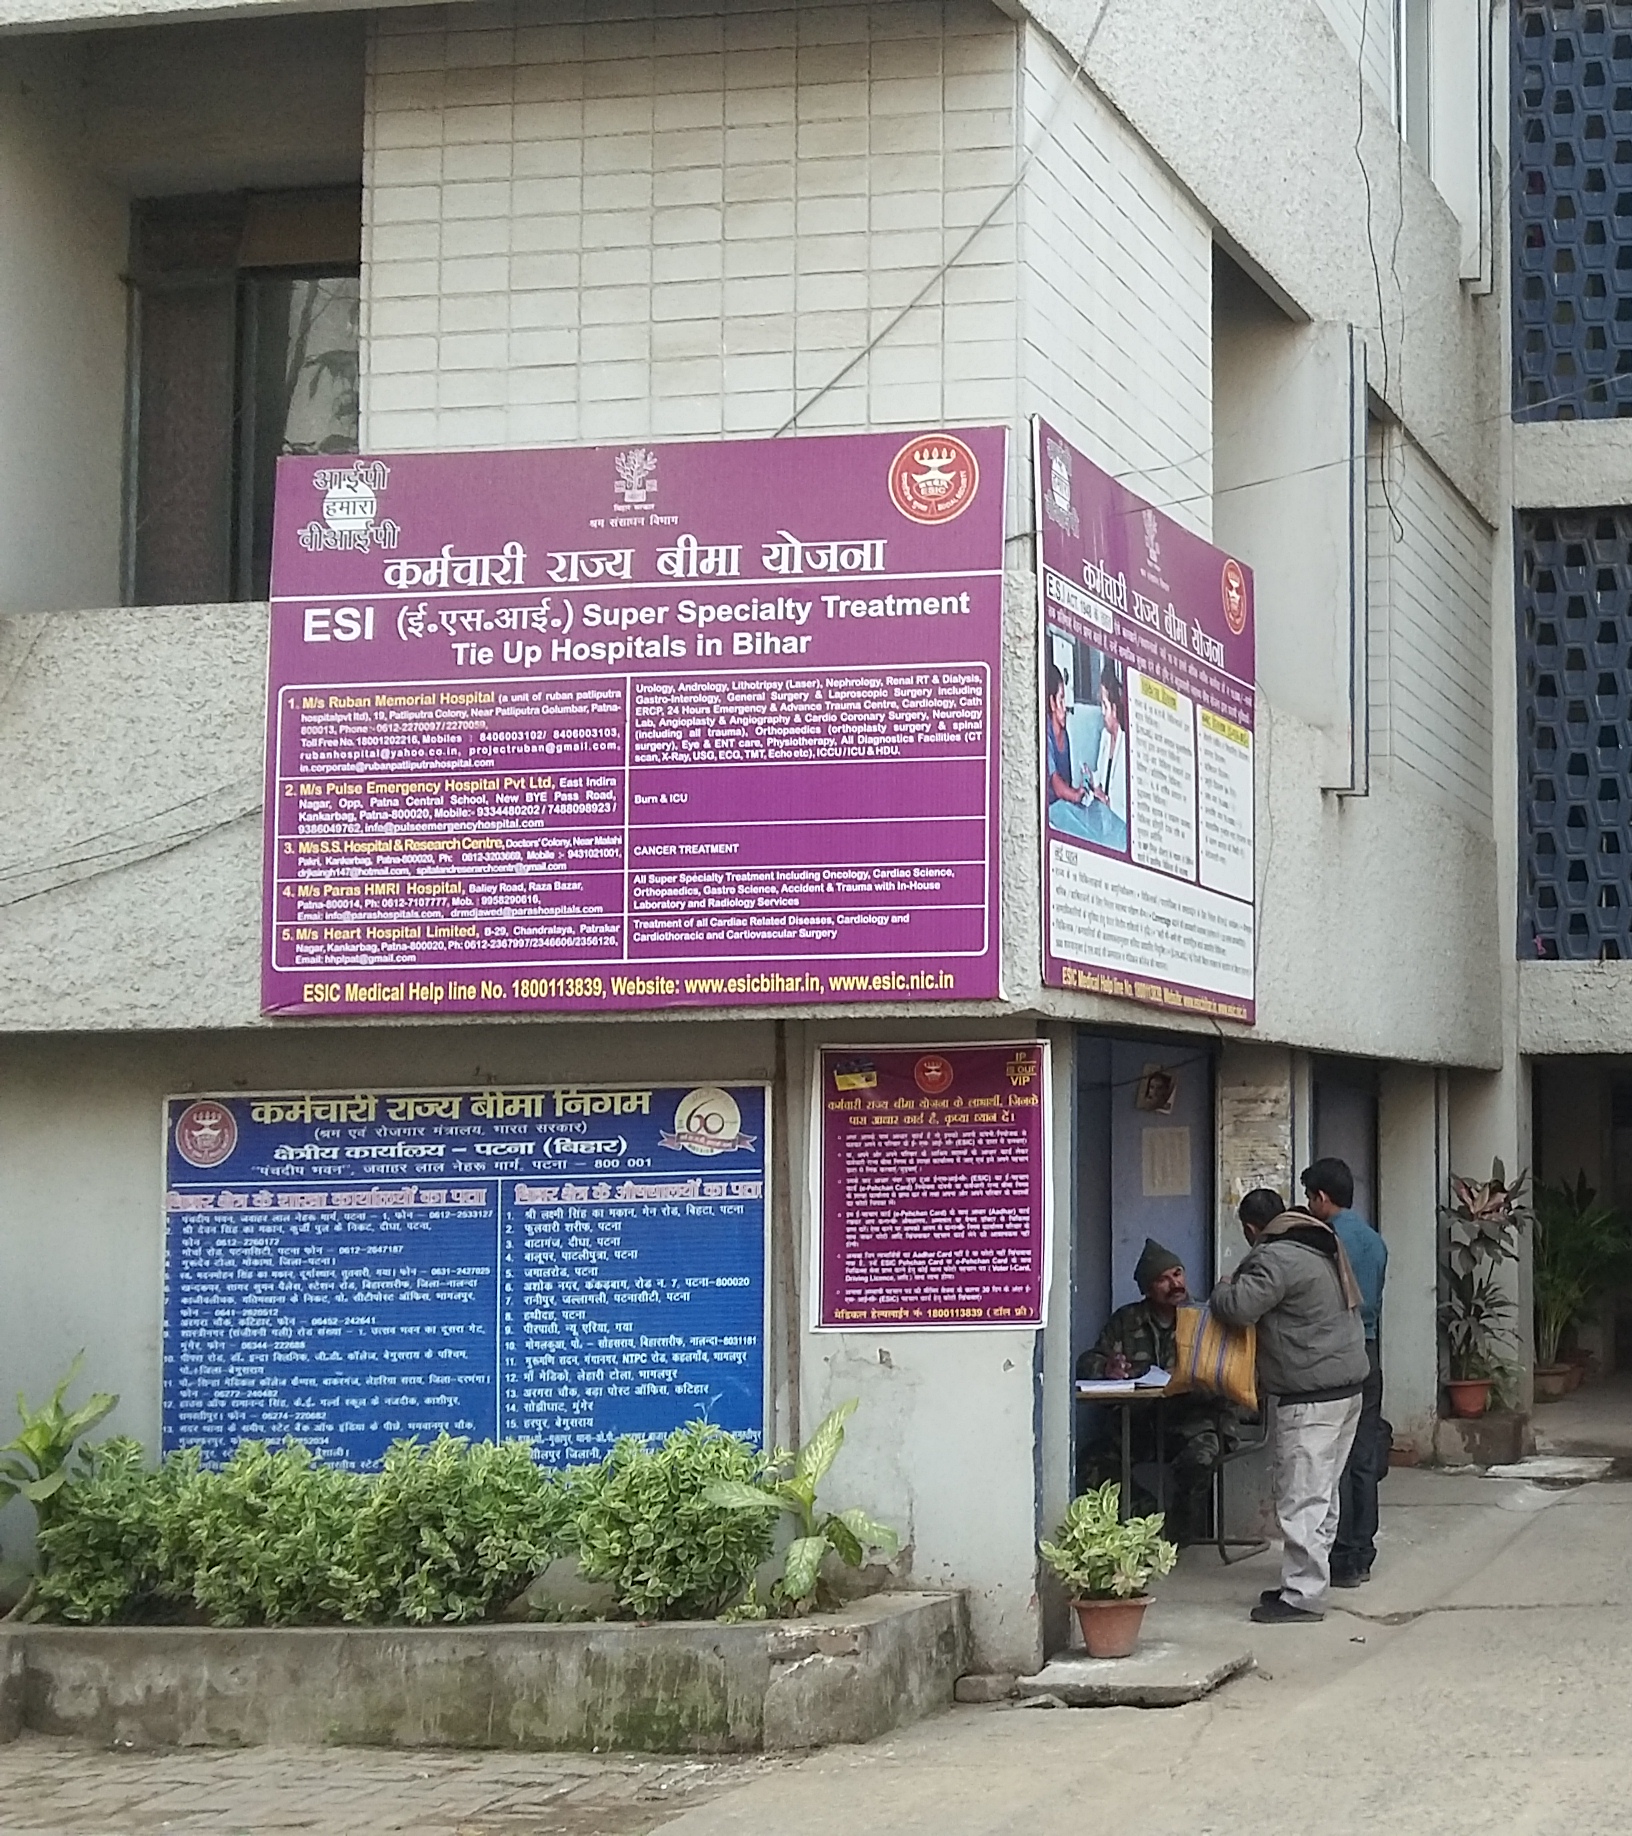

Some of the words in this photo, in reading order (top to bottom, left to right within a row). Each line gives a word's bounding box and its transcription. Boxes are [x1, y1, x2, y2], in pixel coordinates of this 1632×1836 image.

[326, 500, 374, 516] हमारा
[649, 514, 678, 525] विभाग
[383, 542, 527, 590] कर्मचारी
[546, 549, 635, 582] राज्य
[655, 534, 743, 577] बीमा
[761, 531, 887, 573] योजना
[303, 607, 374, 641] ESI
[582, 604, 669, 629] Super
[676, 598, 812, 626] Specialty
[820, 592, 970, 617] Treatment
[1082, 558, 1128, 613] कर्मचारी
[1131, 589, 1160, 631] राज्य
[1163, 602, 1188, 647] बीमा
[1190, 617, 1225, 669] योजना
[451, 642, 493, 665] Tie
[503, 640, 541, 667] Up
[551, 635, 686, 663] Hospitals
[696, 633, 722, 656] in
[732, 632, 812, 654] Bihar
[635, 683, 675, 694] Urology,
[677, 682, 729, 692] Andrology,
[731, 680, 783, 690] Lithotripsy
[785, 678, 823, 690] (Laser),
[825, 677, 883, 688] Nephrology,
[885, 675, 913, 685] Renal
[915, 674, 930, 684] RT
[931, 674, 939, 684] &
[942, 674, 982, 685] Dialysis,
[287, 697, 299, 709] 1.
[302, 696, 325, 708] M/s
[328, 696, 371, 707] Ruban
[374, 693, 436, 706] Memorial
[439, 691, 494, 705] Hospital
[510, 692, 529, 702] unit
[531, 691, 542, 701] of
[545, 691, 573, 700] ruban
[575, 689, 621, 700] patliputra
[284, 783, 297, 796] 2.
[299, 783, 322, 795] M/s
[326, 782, 362, 794] Pulse
[366, 781, 441, 795] Emergency
[444, 778, 499, 793] Hospital
[503, 777, 526, 789] Pvt
[529, 776, 555, 789] Ltd,
[559, 777, 583, 787] East
[585, 776, 616, 786] Indira
[634, 794, 658, 804] Burn
[659, 793, 667, 803] &
[669, 793, 687, 803] ICU
[633, 845, 676, 855] CANCER
[678, 843, 739, 854] TREATMENT
[282, 885, 294, 897] 4.
[297, 884, 320, 897] M/s
[323, 884, 361, 896] Paras
[364, 882, 399, 895] HMRI
[406, 881, 465, 895] Hospital,
[499, 882, 526, 892] Road,
[527, 881, 552, 891] Raza
[553, 881, 583, 890] Bazar,
[281, 928, 293, 940] 5.
[296, 928, 318, 940] M/s
[323, 927, 361, 939] Heart
[366, 926, 421, 940] Hospital
[426, 924, 479, 938] Limited,
[579, 923, 620, 933] Patrakar
[303, 983, 340, 1002] ESIC
[345, 982, 404, 1001] Medical
[408, 982, 444, 1003] Help
[448, 981, 476, 999] line
[480, 980, 506, 998] No.
[511, 977, 606, 997] 1800113839,
[610, 976, 679, 995] Website:
[684, 973, 824, 993] www.esicbihar.in,
[828, 970, 953, 990] www.esic.nic.in
[1010, 1075, 1031, 1086] VIP
[249, 1093, 379, 1123] कर्मचारी
[385, 1097, 463, 1120] राज्य
[469, 1090, 545, 1118] बीमा
[552, 1087, 652, 1116] निगम
[827, 1097, 861, 1110] कर्मचारी
[866, 1100, 888, 1109] राज्य
[893, 1097, 914, 1109] बीमा
[918, 1097, 948, 1108] योजना
[953, 1095, 963, 1108] के
[685, 1098, 725, 1135] 60
[848, 1116, 866, 1125] पास
[347, 1126, 367, 1139] एवं
[374, 1125, 425, 1137] रोजगार
[493, 1124, 528, 1133] भारत
[535, 1120, 587, 1134] सरकार)
[273, 1144, 340, 1160] क्षेत्रीय
[344, 1141, 446, 1158] कार्यालय
[473, 1142, 535, 1155] पटना
[543, 1137, 627, 1157] (बिहार)
[363, 1163, 407, 1173] जवाहर
[415, 1163, 444, 1172] लाल
[531, 1159, 567, 1169] पटना
[594, 1159, 619, 1168] 800
[627, 1158, 651, 1167] 001
[505, 1224, 514, 1234] 2.
[597, 1221, 621, 1231] पटना
[926, 1308, 983, 1317] 1800113839
